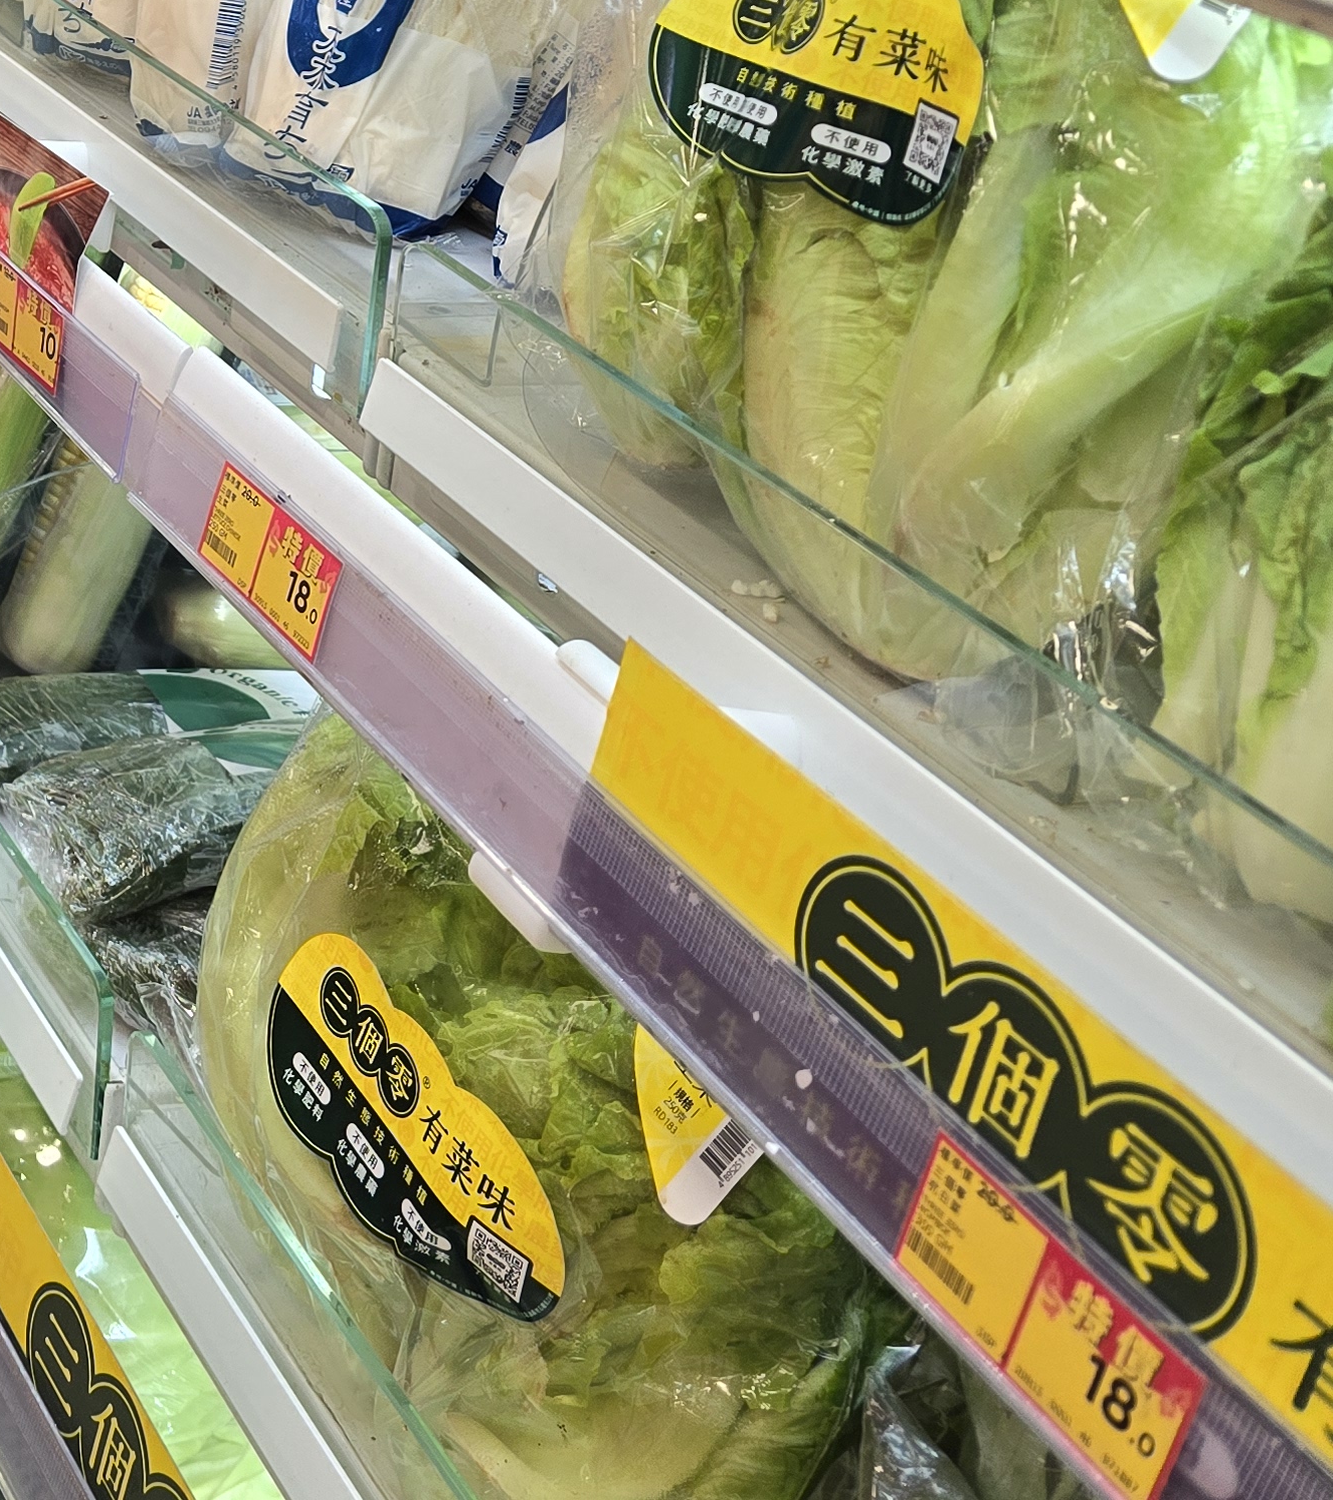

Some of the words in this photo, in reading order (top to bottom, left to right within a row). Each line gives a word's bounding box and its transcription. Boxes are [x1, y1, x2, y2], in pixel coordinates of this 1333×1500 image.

[823, 14, 951, 94] 有菜味
[800, 145, 886, 187] 化學激素
[824, 127, 881, 158] 不使用
[39, 327, 56, 360] 10
[281, 525, 325, 587] 特價
[288, 570, 319, 625] 18.0
[323, 979, 415, 1104] 三個零
[281, 1066, 324, 1123] 化學肥料
[297, 1059, 327, 1101] 不使用
[673, 1086, 694, 1113] 規格
[815, 898, 1220, 1284] 三個零
[319, 1052, 428, 1207] 自然生態技術種植
[662, 1097, 688, 1125] 250克
[335, 1137, 380, 1198] 化學農藥
[351, 1129, 381, 1172] 不使用
[419, 1104, 516, 1232] 有菜味
[392, 1214, 453, 1266] 化學激素
[406, 1205, 442, 1246] 不使用
[1068, 1279, 1166, 1390] 特價
[34, 1312, 136, 1500] 三個
[1086, 1355, 1156, 1459] 18.0
